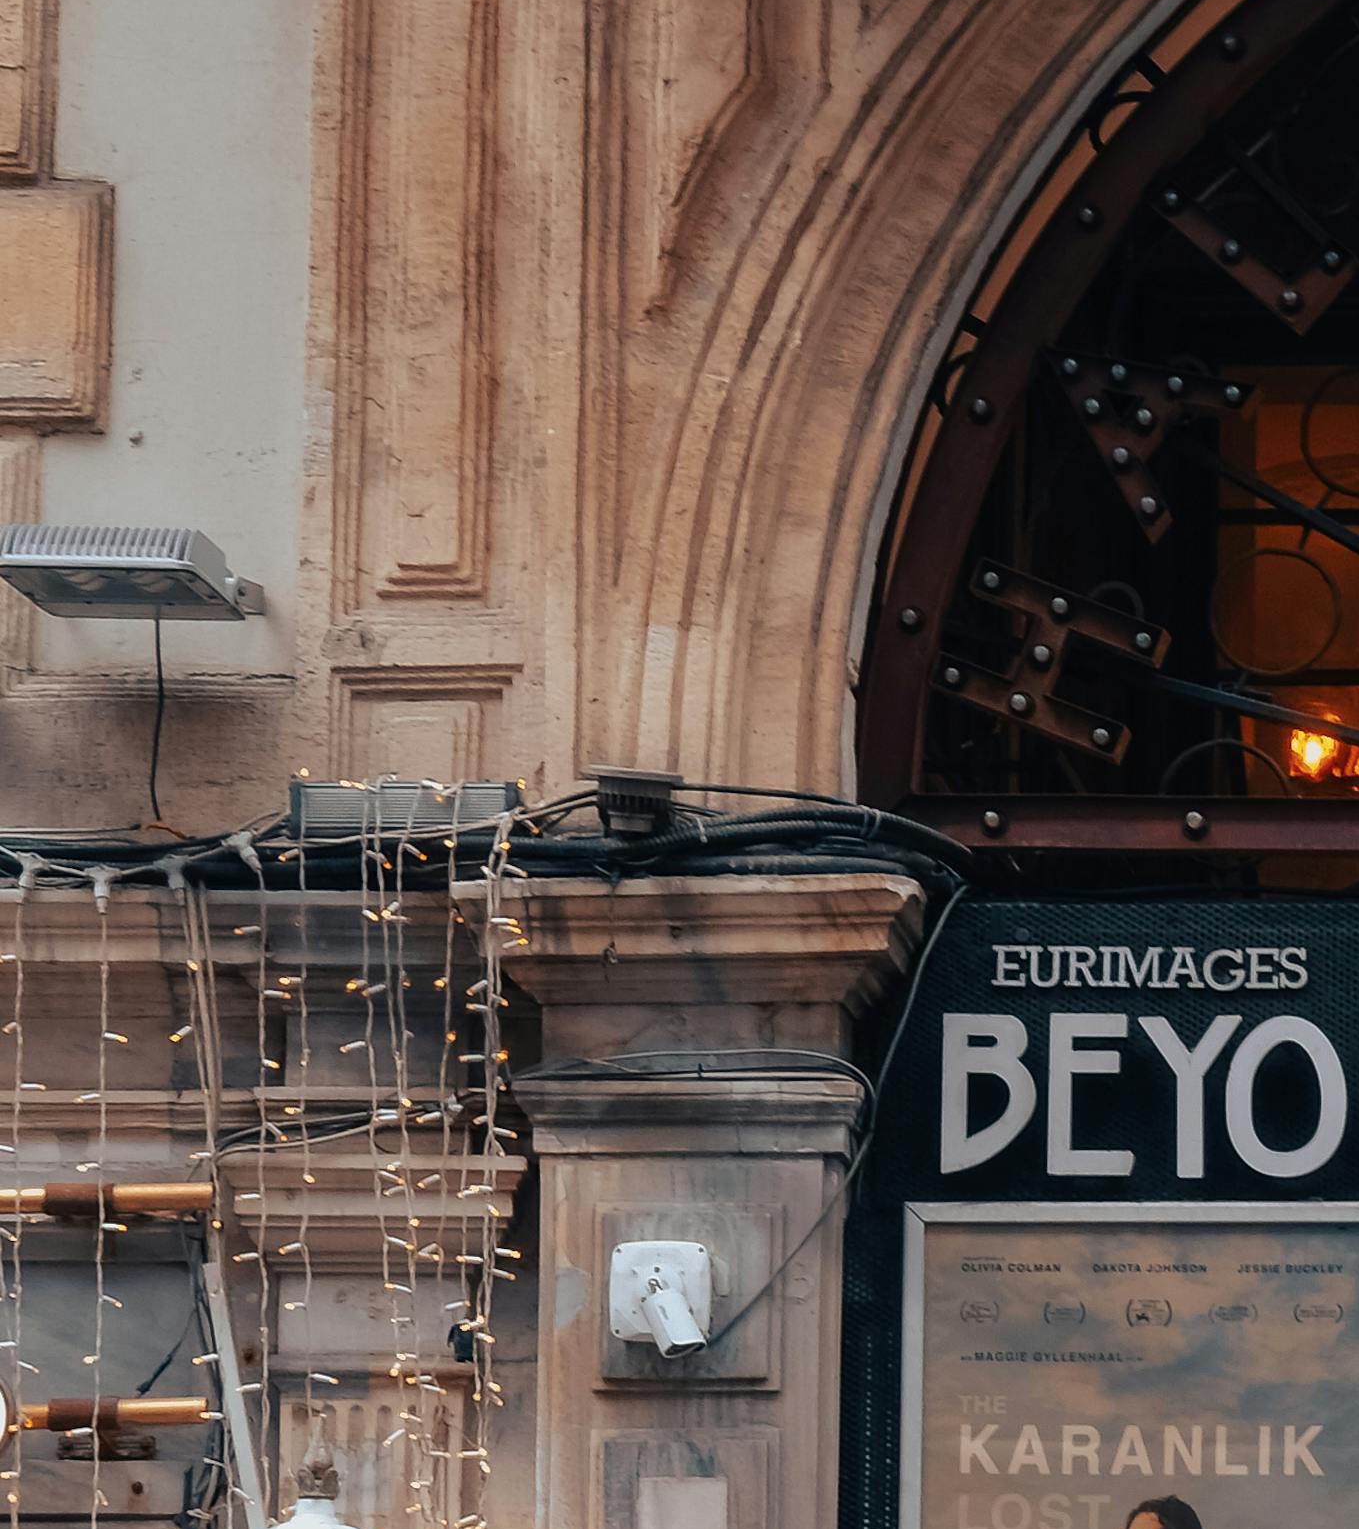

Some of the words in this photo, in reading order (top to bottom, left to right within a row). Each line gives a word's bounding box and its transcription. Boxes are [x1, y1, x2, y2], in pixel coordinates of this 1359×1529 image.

[991, 944, 1308, 991] EURIMAGES
[959, 1395, 1007, 1416] THE
[959, 1423, 1325, 1477] KARANLIK
